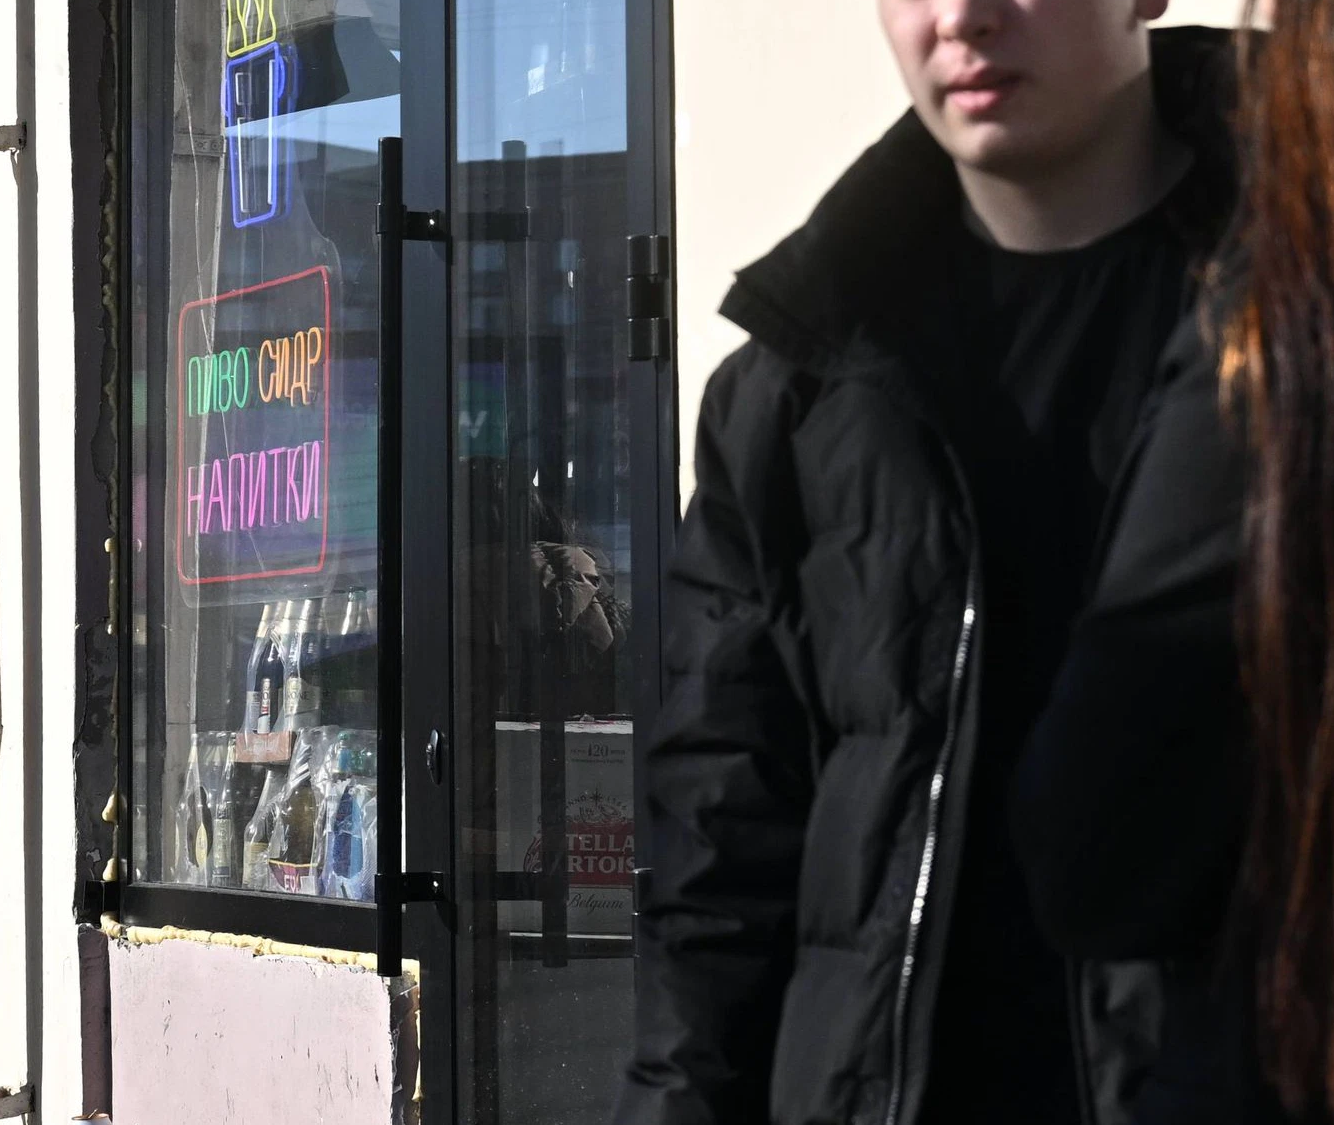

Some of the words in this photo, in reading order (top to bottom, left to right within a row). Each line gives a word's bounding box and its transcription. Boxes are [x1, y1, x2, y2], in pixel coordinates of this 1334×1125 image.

[188, 347, 250, 417] ПИВО
[258, 326, 322, 408] СИДР
[187, 440, 321, 537] НАПИТКИ
[566, 834, 635, 854] TELLA
[567, 855, 635, 873] RTOIS
[568, 893, 624, 911] Belgium
